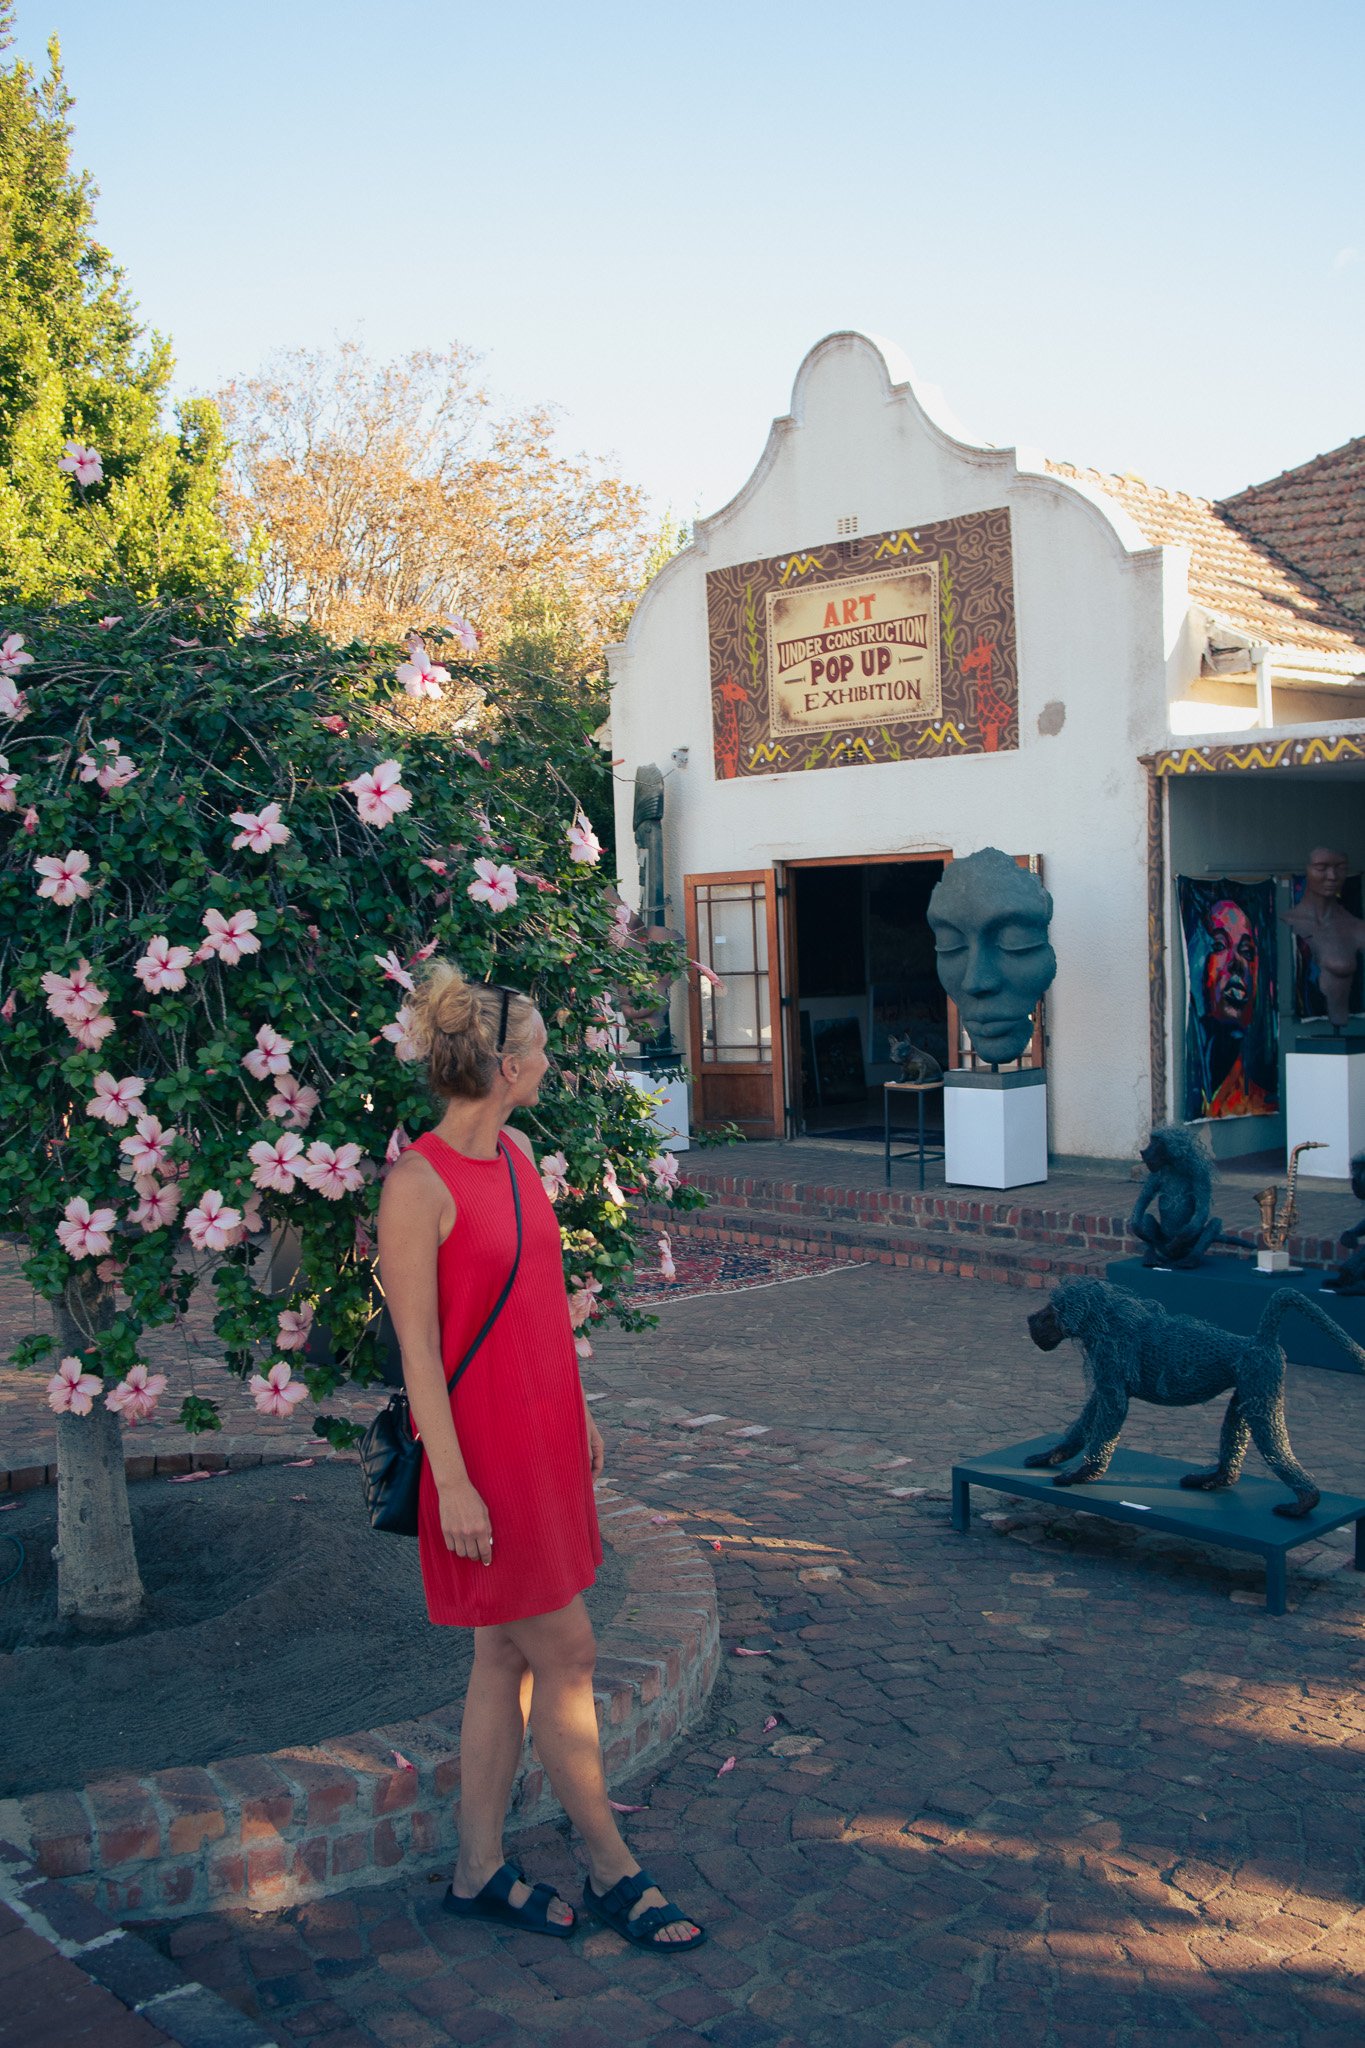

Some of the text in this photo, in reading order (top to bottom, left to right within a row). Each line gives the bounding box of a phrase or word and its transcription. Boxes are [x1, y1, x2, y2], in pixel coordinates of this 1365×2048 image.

[823, 593, 876, 628] ART
[780, 616, 926, 668] UNDER CONSTRUCTION
[811, 646, 892, 686] POP UP
